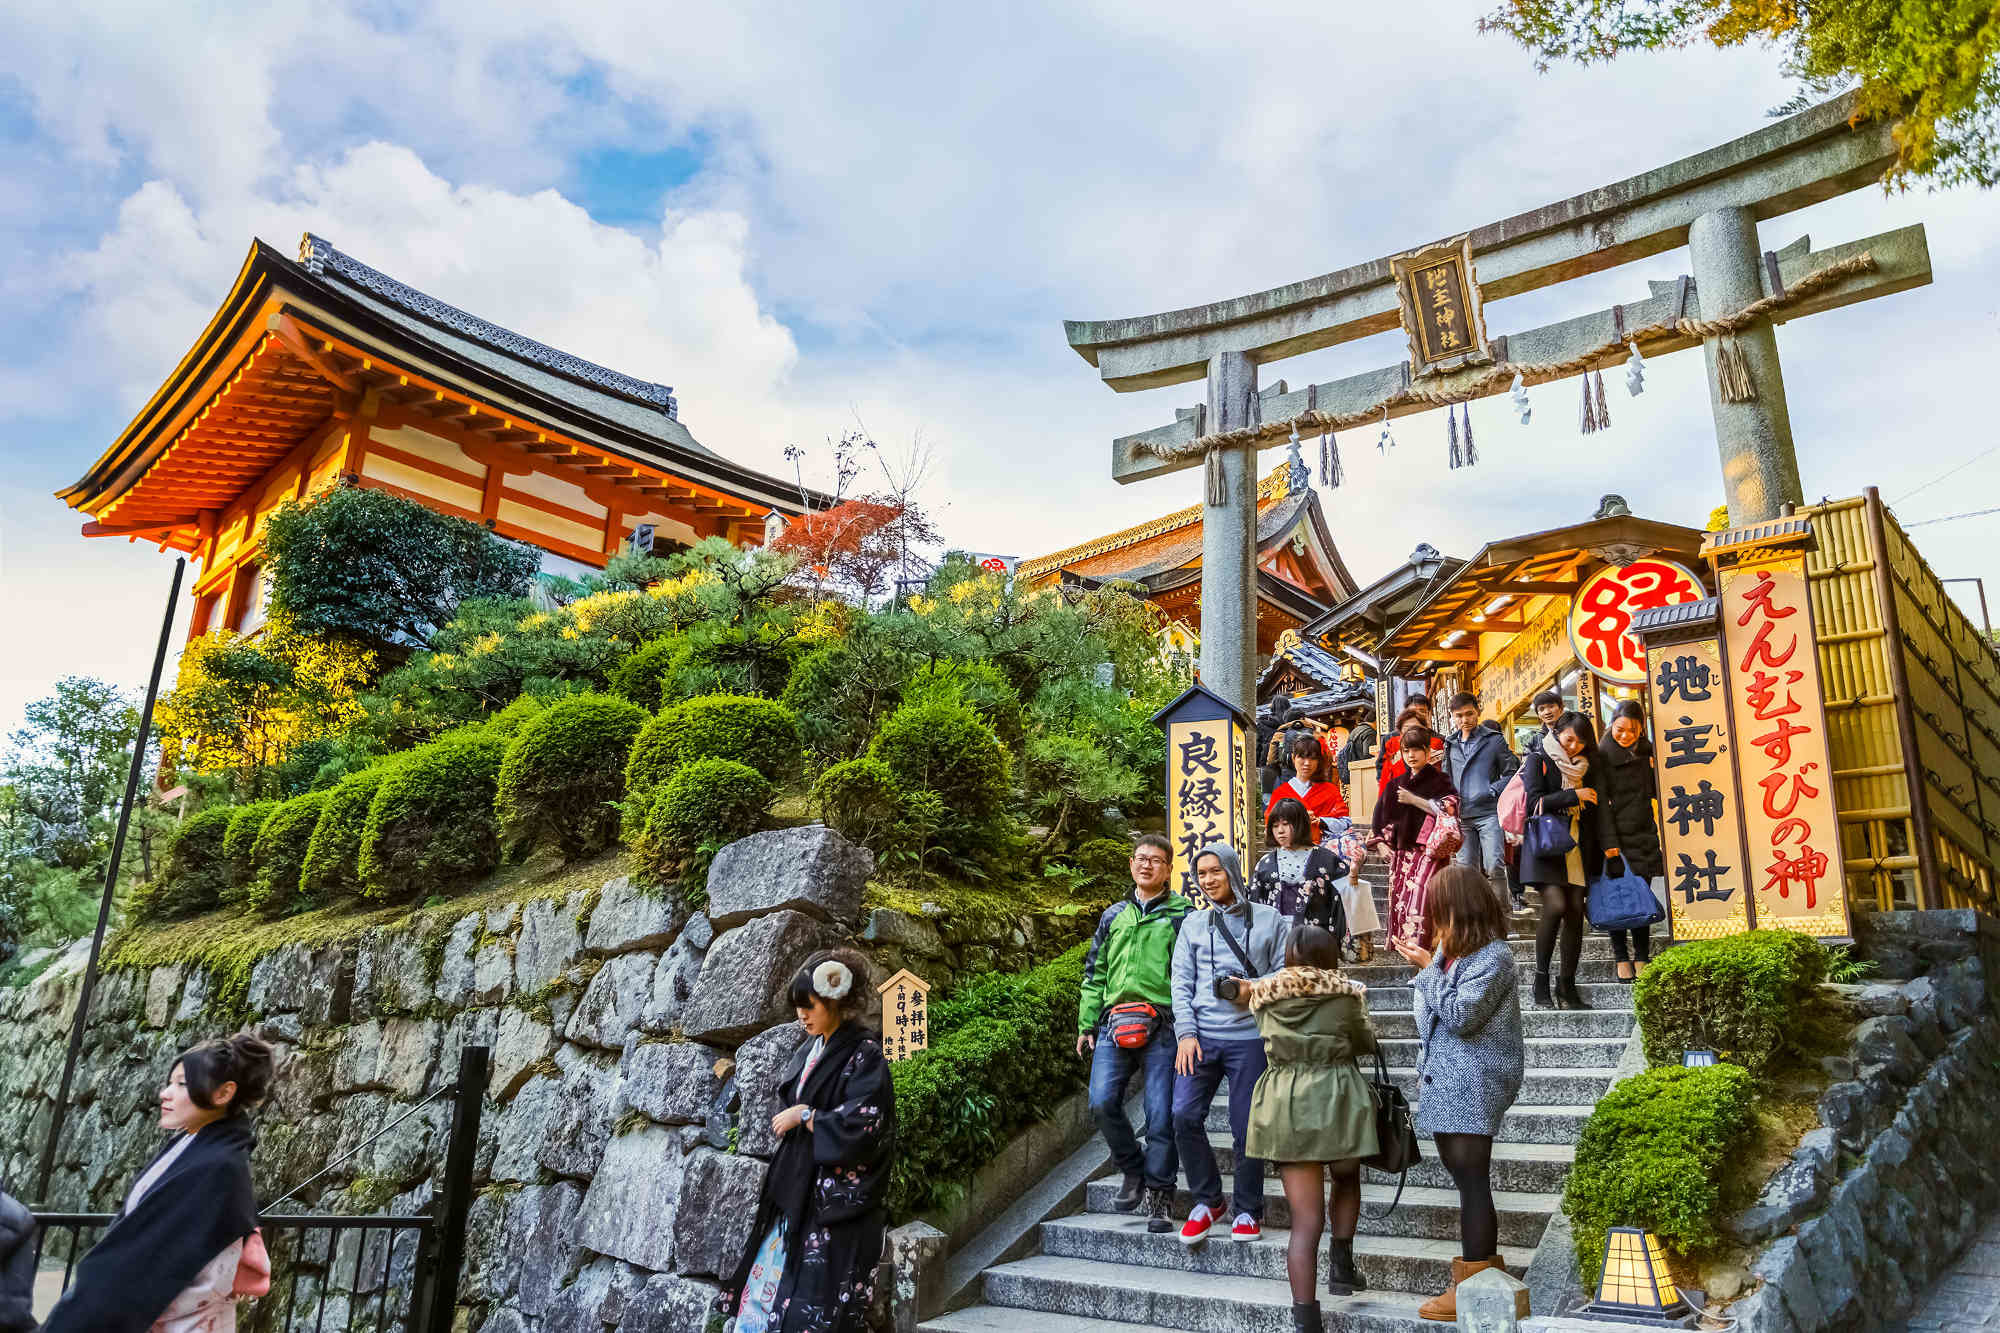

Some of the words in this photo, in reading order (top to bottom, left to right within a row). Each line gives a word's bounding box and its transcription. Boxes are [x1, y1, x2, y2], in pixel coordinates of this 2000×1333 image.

[1426, 267, 1460, 348] 地主神社
[1656, 655, 1736, 904] 地主神社
[1737, 570, 1830, 909] えんむすびの神
